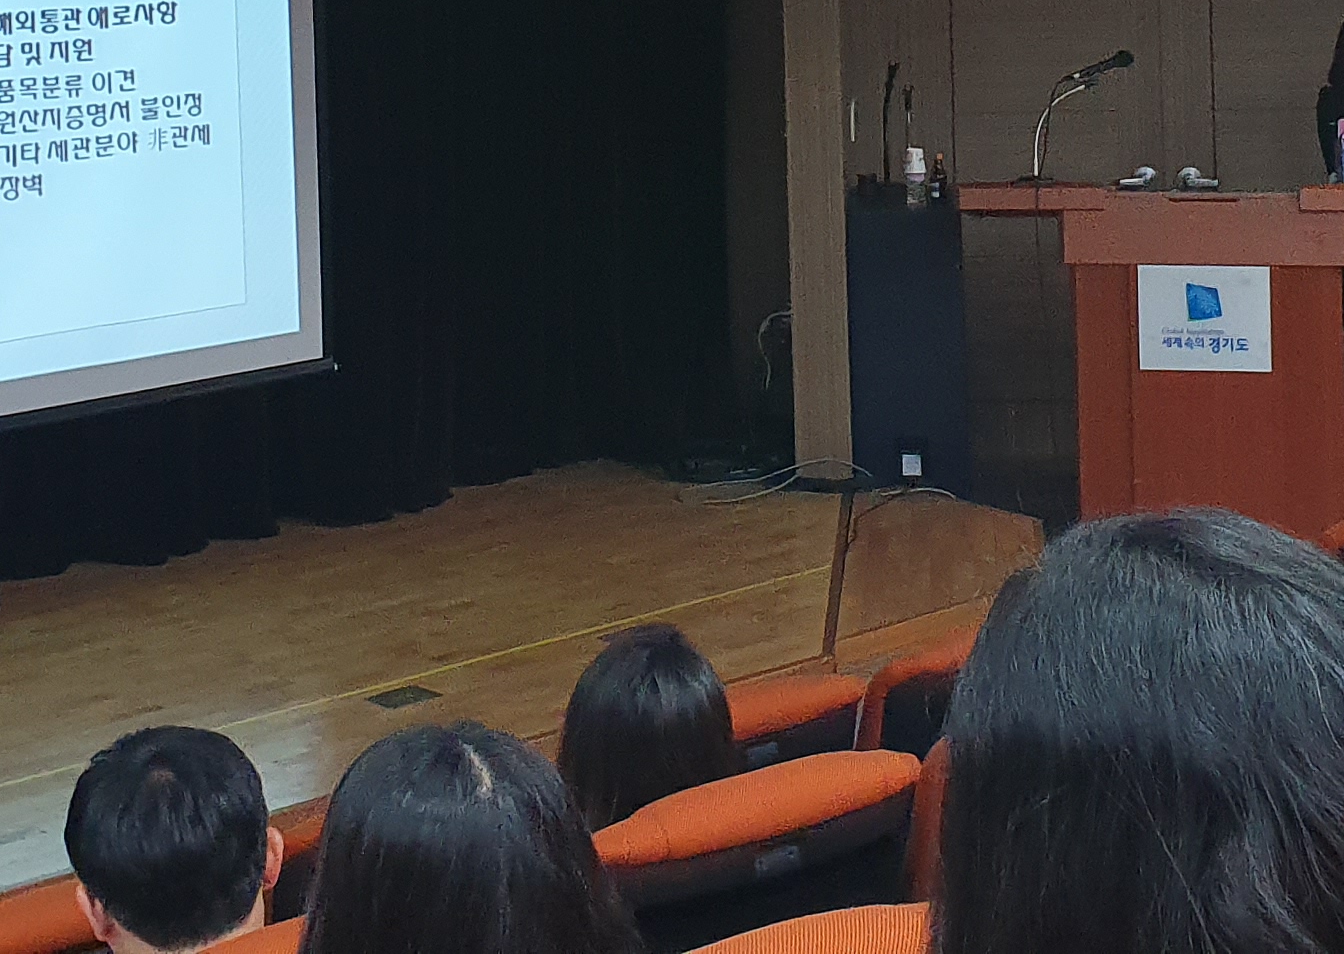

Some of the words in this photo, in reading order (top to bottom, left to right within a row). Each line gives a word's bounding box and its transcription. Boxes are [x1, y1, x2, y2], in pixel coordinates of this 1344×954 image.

[49, 38, 93, 63] 지원
[92, 69, 136, 93] 이견
[47, 131, 138, 162] 세관분야
[0, 174, 43, 201] 장벽
[1209, 337, 1249, 354] 경기도
